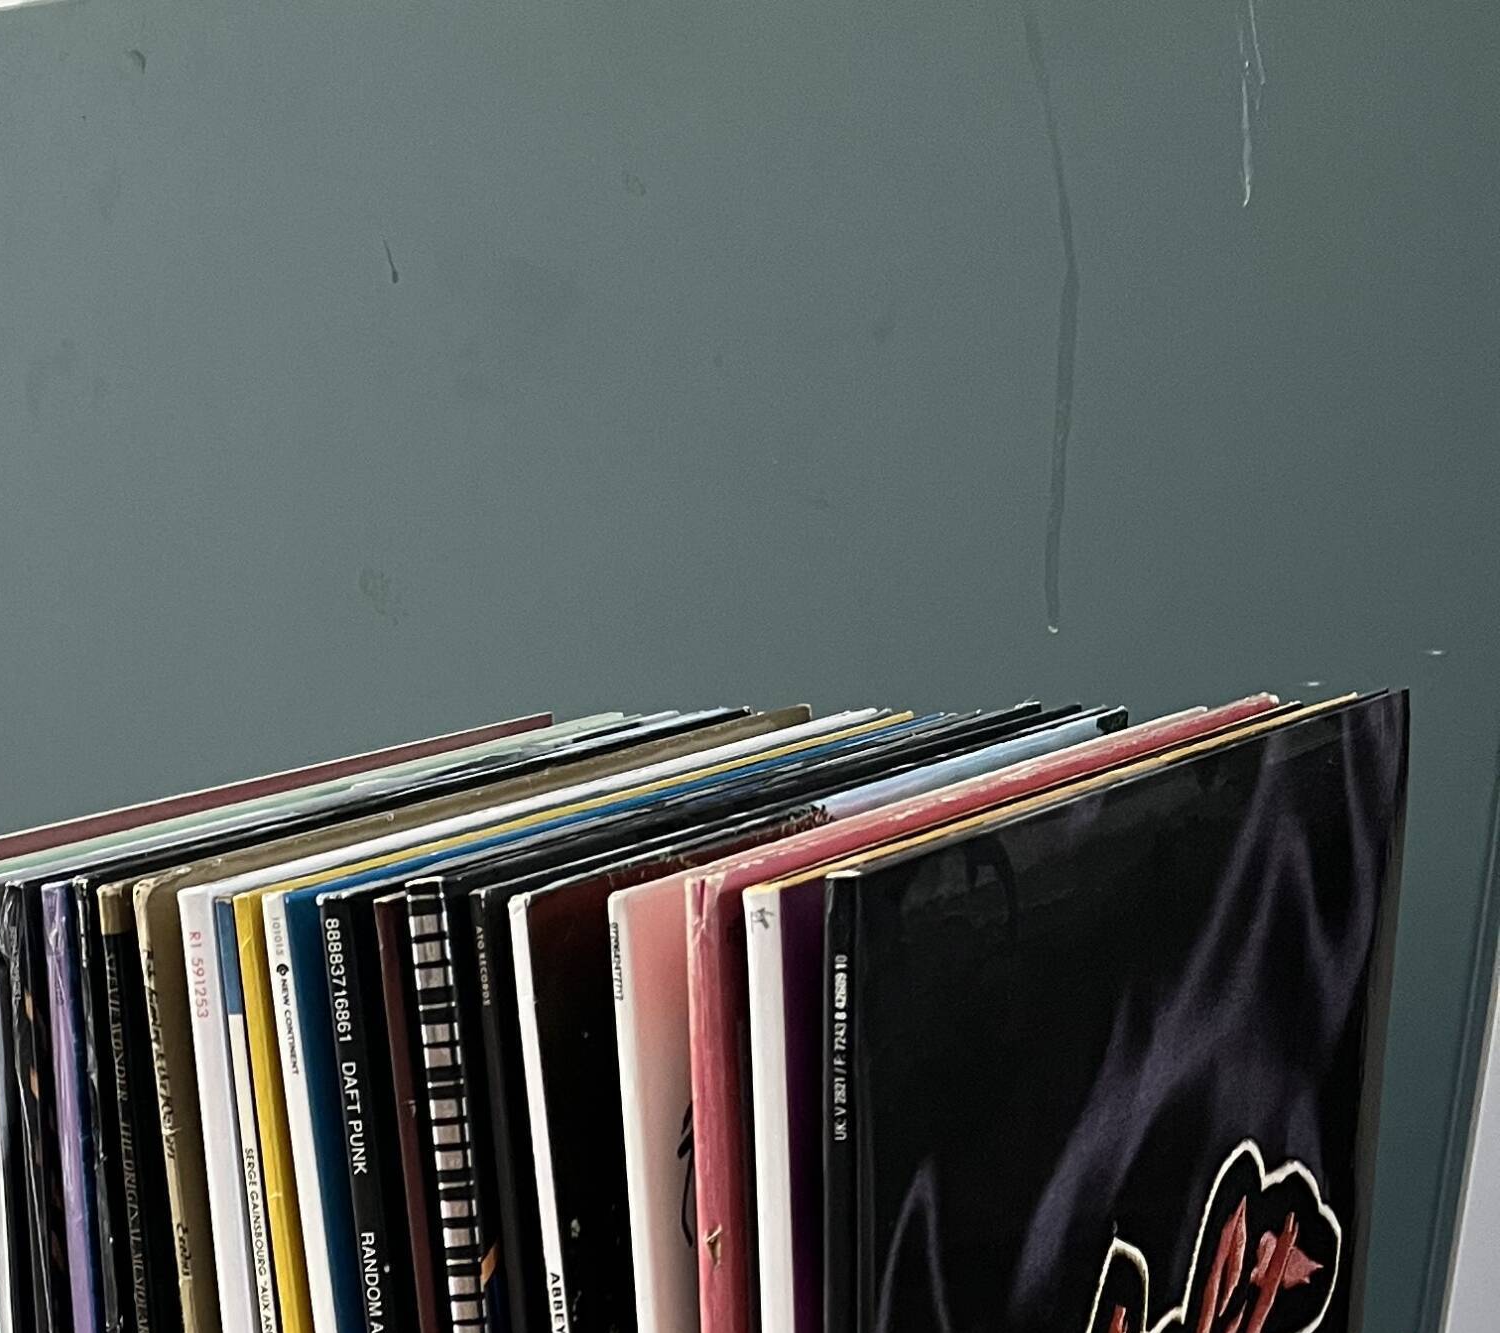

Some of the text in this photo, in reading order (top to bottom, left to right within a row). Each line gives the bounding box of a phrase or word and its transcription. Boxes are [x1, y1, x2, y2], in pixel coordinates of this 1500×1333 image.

[191, 957, 209, 1020] 591253
[325, 918, 351, 1042] 88883716861
[475, 925, 491, 1007] ATO RECORDS
[281, 977, 299, 1076] NEW CONTINENT
[341, 1061, 367, 1175] DAFT PUNK
[244, 1147, 258, 1187] SERGE
[249, 1190, 267, 1277] GAINSBOURG
[360, 1232, 387, 1317] RANDOM
